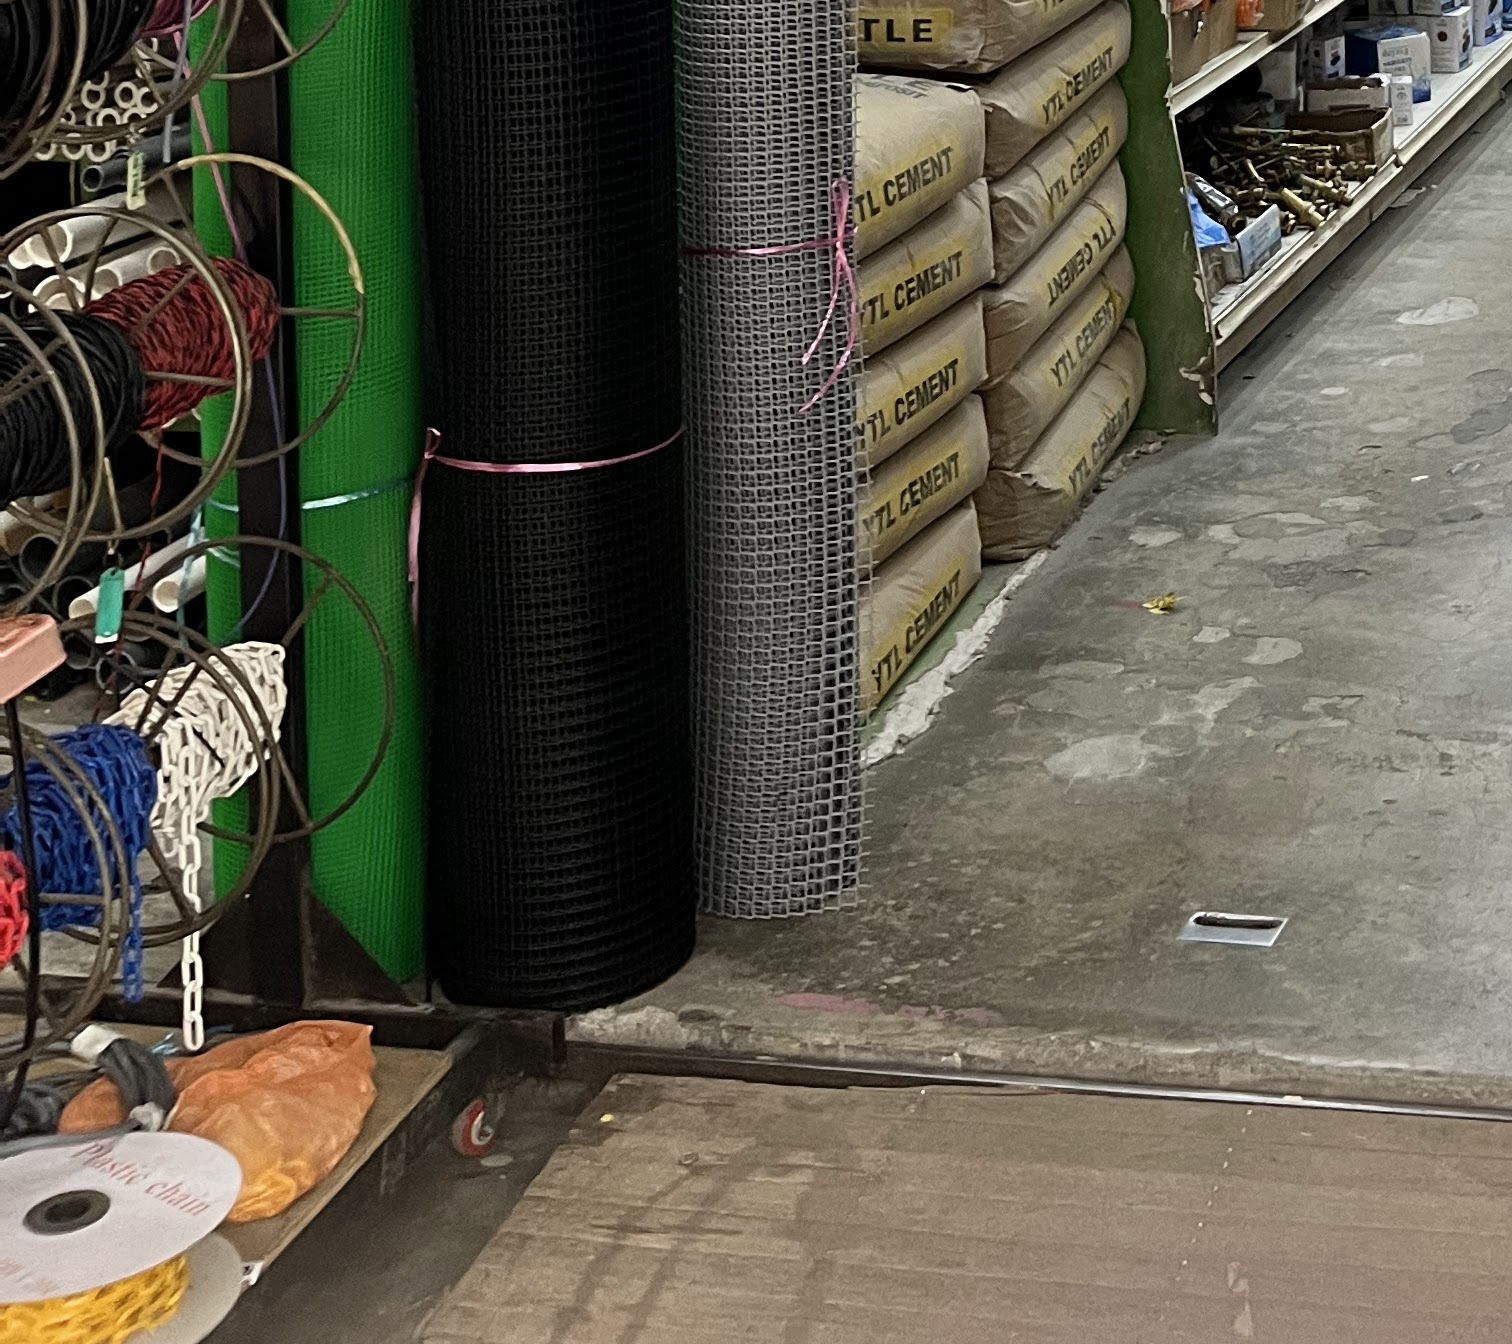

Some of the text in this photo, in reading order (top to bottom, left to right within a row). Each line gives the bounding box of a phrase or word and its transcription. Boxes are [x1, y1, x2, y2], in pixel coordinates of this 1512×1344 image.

[859, 17, 934, 44] TLE
[1042, 46, 1114, 125] YTL CEMENT
[855, 146, 953, 223] TL CEMENT
[1070, 126, 1110, 188] CEMENT
[894, 250, 963, 312] CEMENT
[1048, 241, 1094, 307] CEMENT
[894, 358, 959, 427] CEMENT
[1050, 348, 1078, 388] YTL
[862, 451, 960, 548] YTL CEMENT
[871, 568, 962, 694] YTL CEMENT
[71, 1142, 211, 1216] Plastic chain
